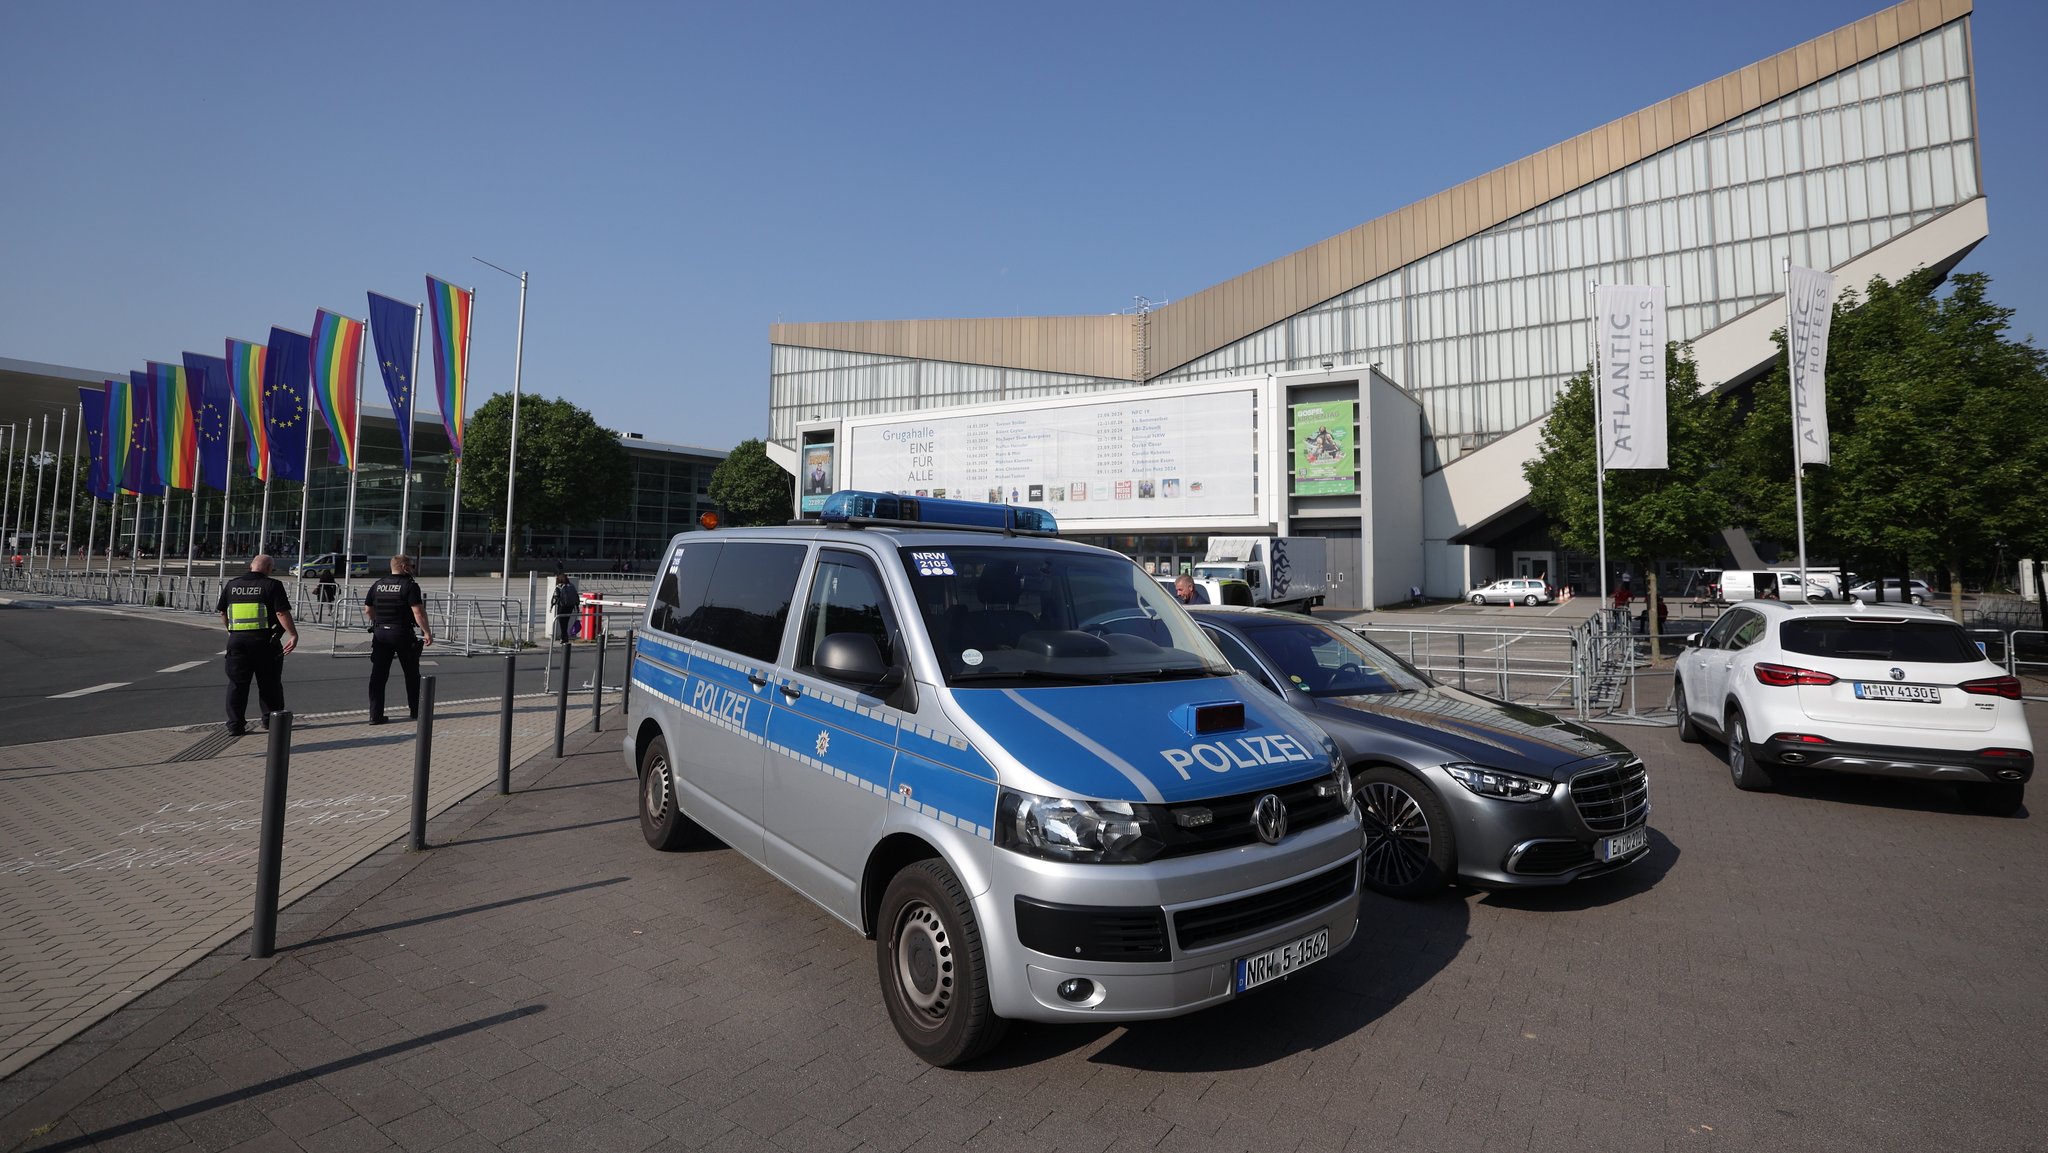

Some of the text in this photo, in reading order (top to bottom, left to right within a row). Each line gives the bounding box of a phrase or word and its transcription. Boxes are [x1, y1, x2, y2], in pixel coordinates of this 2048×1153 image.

[1809, 288, 1826, 373] HOTELS
[1640, 300, 1655, 379] HOTELS
[1611, 314, 1632, 451] ATLANTIC
[1298, 408, 1324, 417] GOSPEL
[883, 427, 934, 442] Grugahalle
[910, 442, 934, 454] EINE
[913, 454, 934, 468] FÜR
[908, 470, 934, 482] ALLE
[912, 552, 945, 560] NRW
[920, 560, 948, 568] 2105
[231, 586, 262, 596] POLIZEI
[376, 584, 402, 593] POLIZEI
[1863, 685, 1872, 695] M
[1880, 685, 1894, 696] HY
[692, 679, 751, 729] POLIZEI
[1160, 734, 1314, 781] POLIZEI
[1246, 952, 1275, 986] NRW
[1282, 932, 1327, 971] 5-1562
